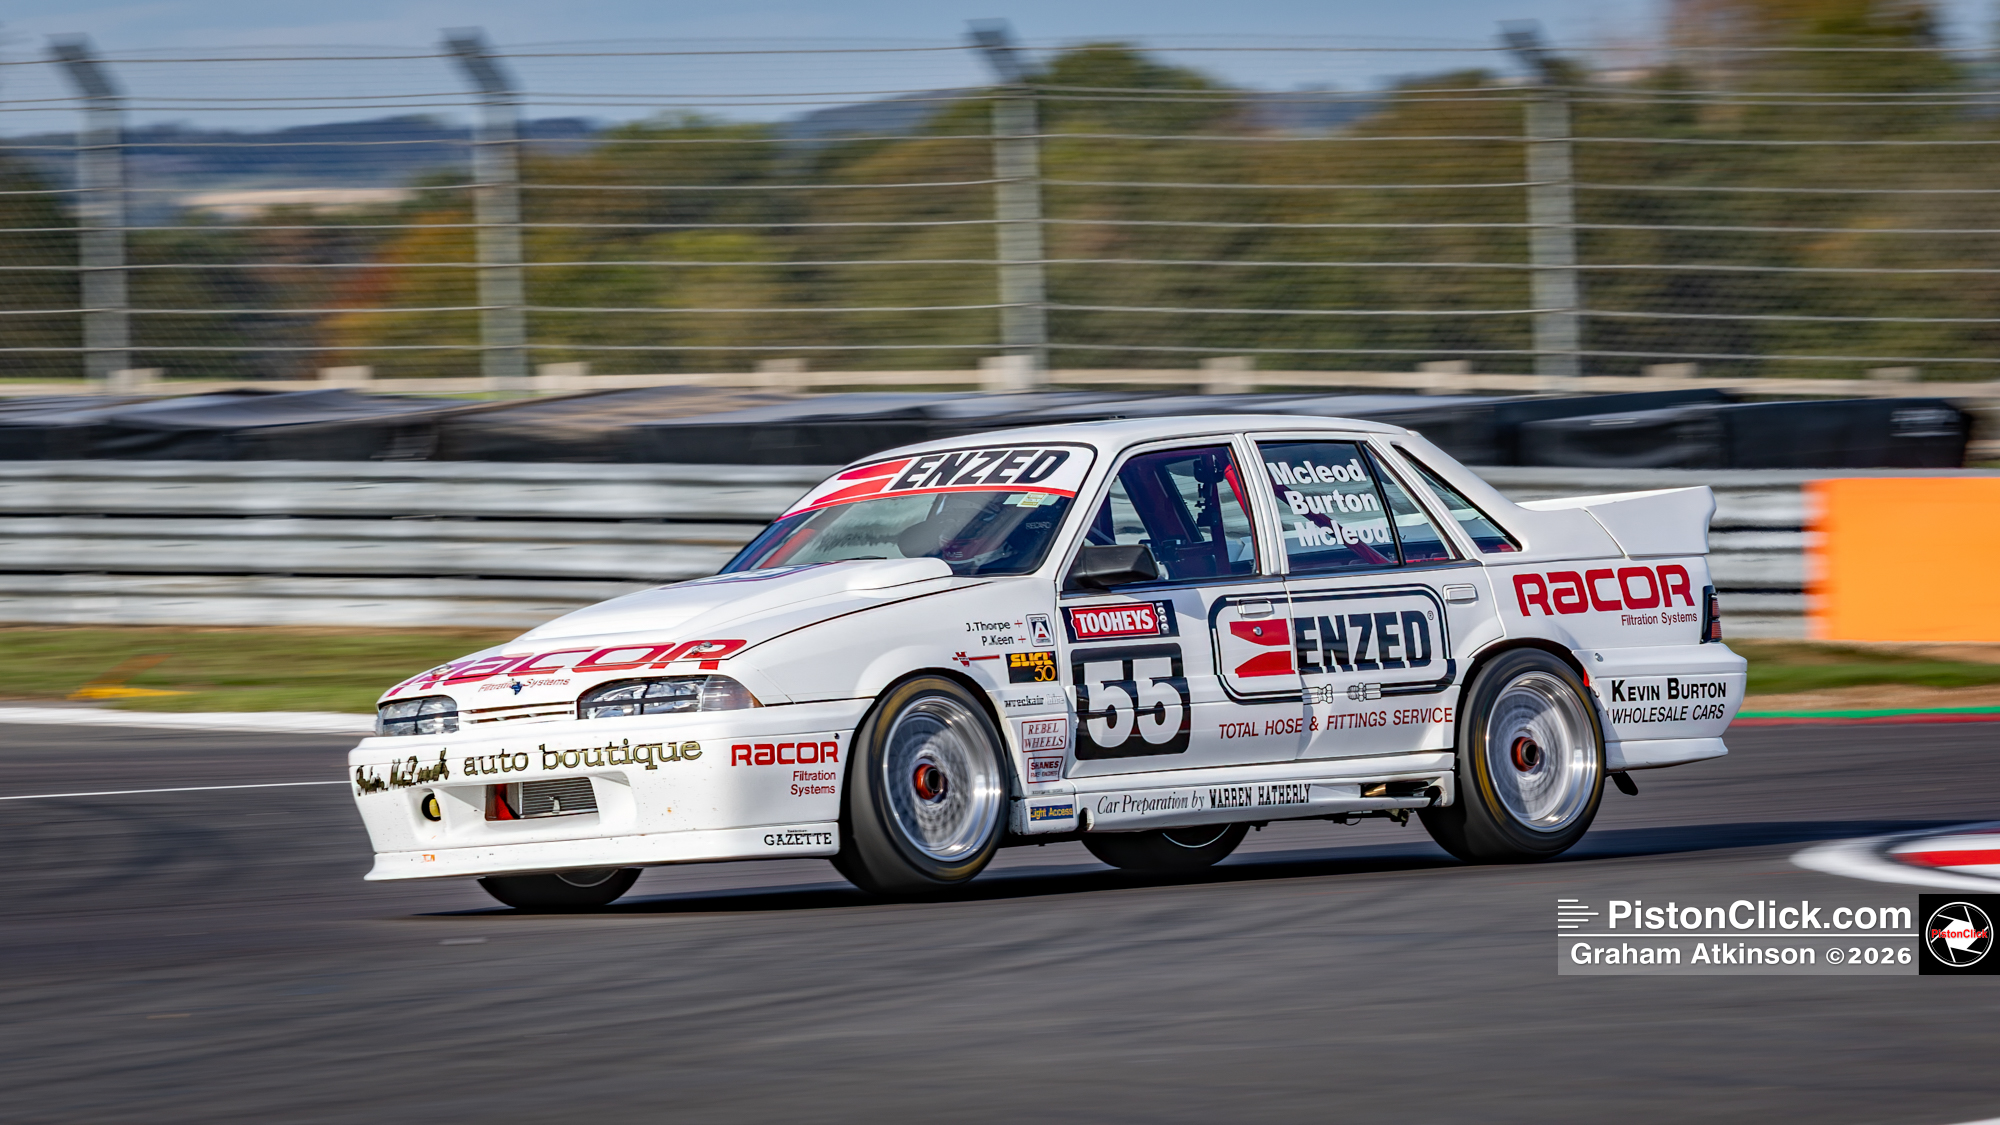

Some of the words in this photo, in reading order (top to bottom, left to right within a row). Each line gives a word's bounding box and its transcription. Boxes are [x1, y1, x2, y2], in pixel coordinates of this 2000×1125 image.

[890, 449, 1071, 491] ENZED
[1265, 458, 1366, 486] Mcleod
[1284, 489, 1381, 515] Burton
[1294, 520, 1391, 547] Mcleod
[1075, 609, 1154, 634] TOOHEYS
[1621, 615, 1658, 626] Filtration
[1661, 612, 1698, 624] Systems
[1294, 610, 1432, 675] ENZED
[524, 678, 571, 688] Systems
[1034, 665, 1056, 682] 50
[1083, 657, 1184, 748] 55
[1611, 706, 1688, 724] WHOLESALE
[1692, 704, 1725, 720] CARS
[1028, 723, 1059, 735] REBEL
[1219, 722, 1259, 740] TOTAL
[1264, 718, 1304, 737] HOSE
[1309, 717, 1319, 732] &
[1326, 711, 1387, 731] FITTINGS
[1392, 707, 1454, 725] SERVICE
[1024, 736, 1064, 748] WHEELS
[463, 748, 529, 776] auto
[538, 738, 703, 771] boutique
[792, 769, 836, 781] Filtration
[790, 784, 836, 797] Systems
[1098, 796, 1119, 815] Car
[1122, 792, 1189, 815] Preparation
[1191, 790, 1204, 811] by
[1209, 787, 1252, 808] WARREN
[1258, 784, 1311, 806] HATHERLY
[764, 832, 832, 846] GAZETTE
